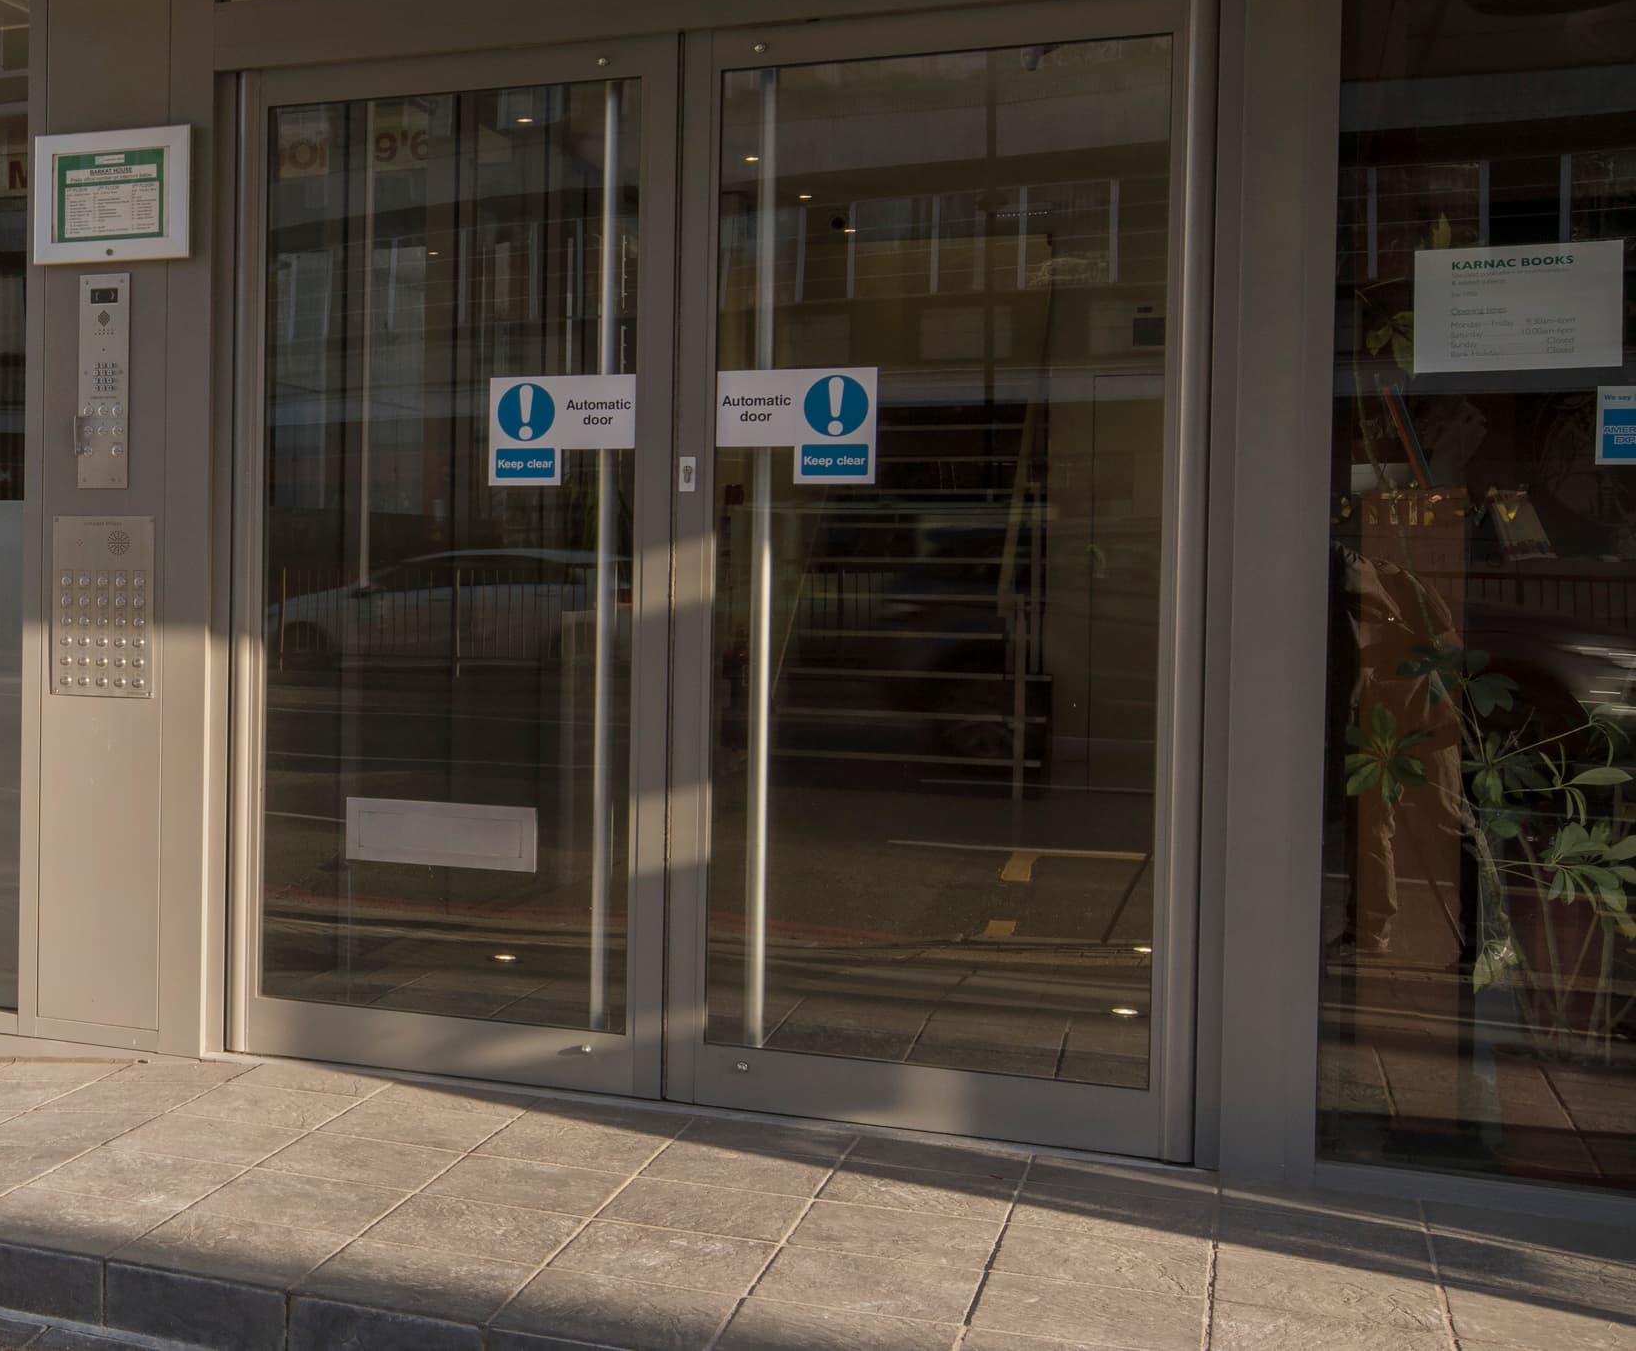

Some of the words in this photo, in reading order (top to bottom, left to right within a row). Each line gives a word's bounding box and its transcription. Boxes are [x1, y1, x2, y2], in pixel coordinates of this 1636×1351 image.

[1451, 258, 1517, 271] KARNAC
[1521, 254, 1574, 267] BOOKS
[565, 398, 632, 412] Automatic
[721, 393, 792, 408] Automatic
[582, 413, 614, 426] door
[739, 410, 773, 423] door
[497, 458, 525, 470] Keep
[526, 457, 554, 469] clear
[803, 455, 834, 468] Keep
[836, 454, 866, 467] clear
